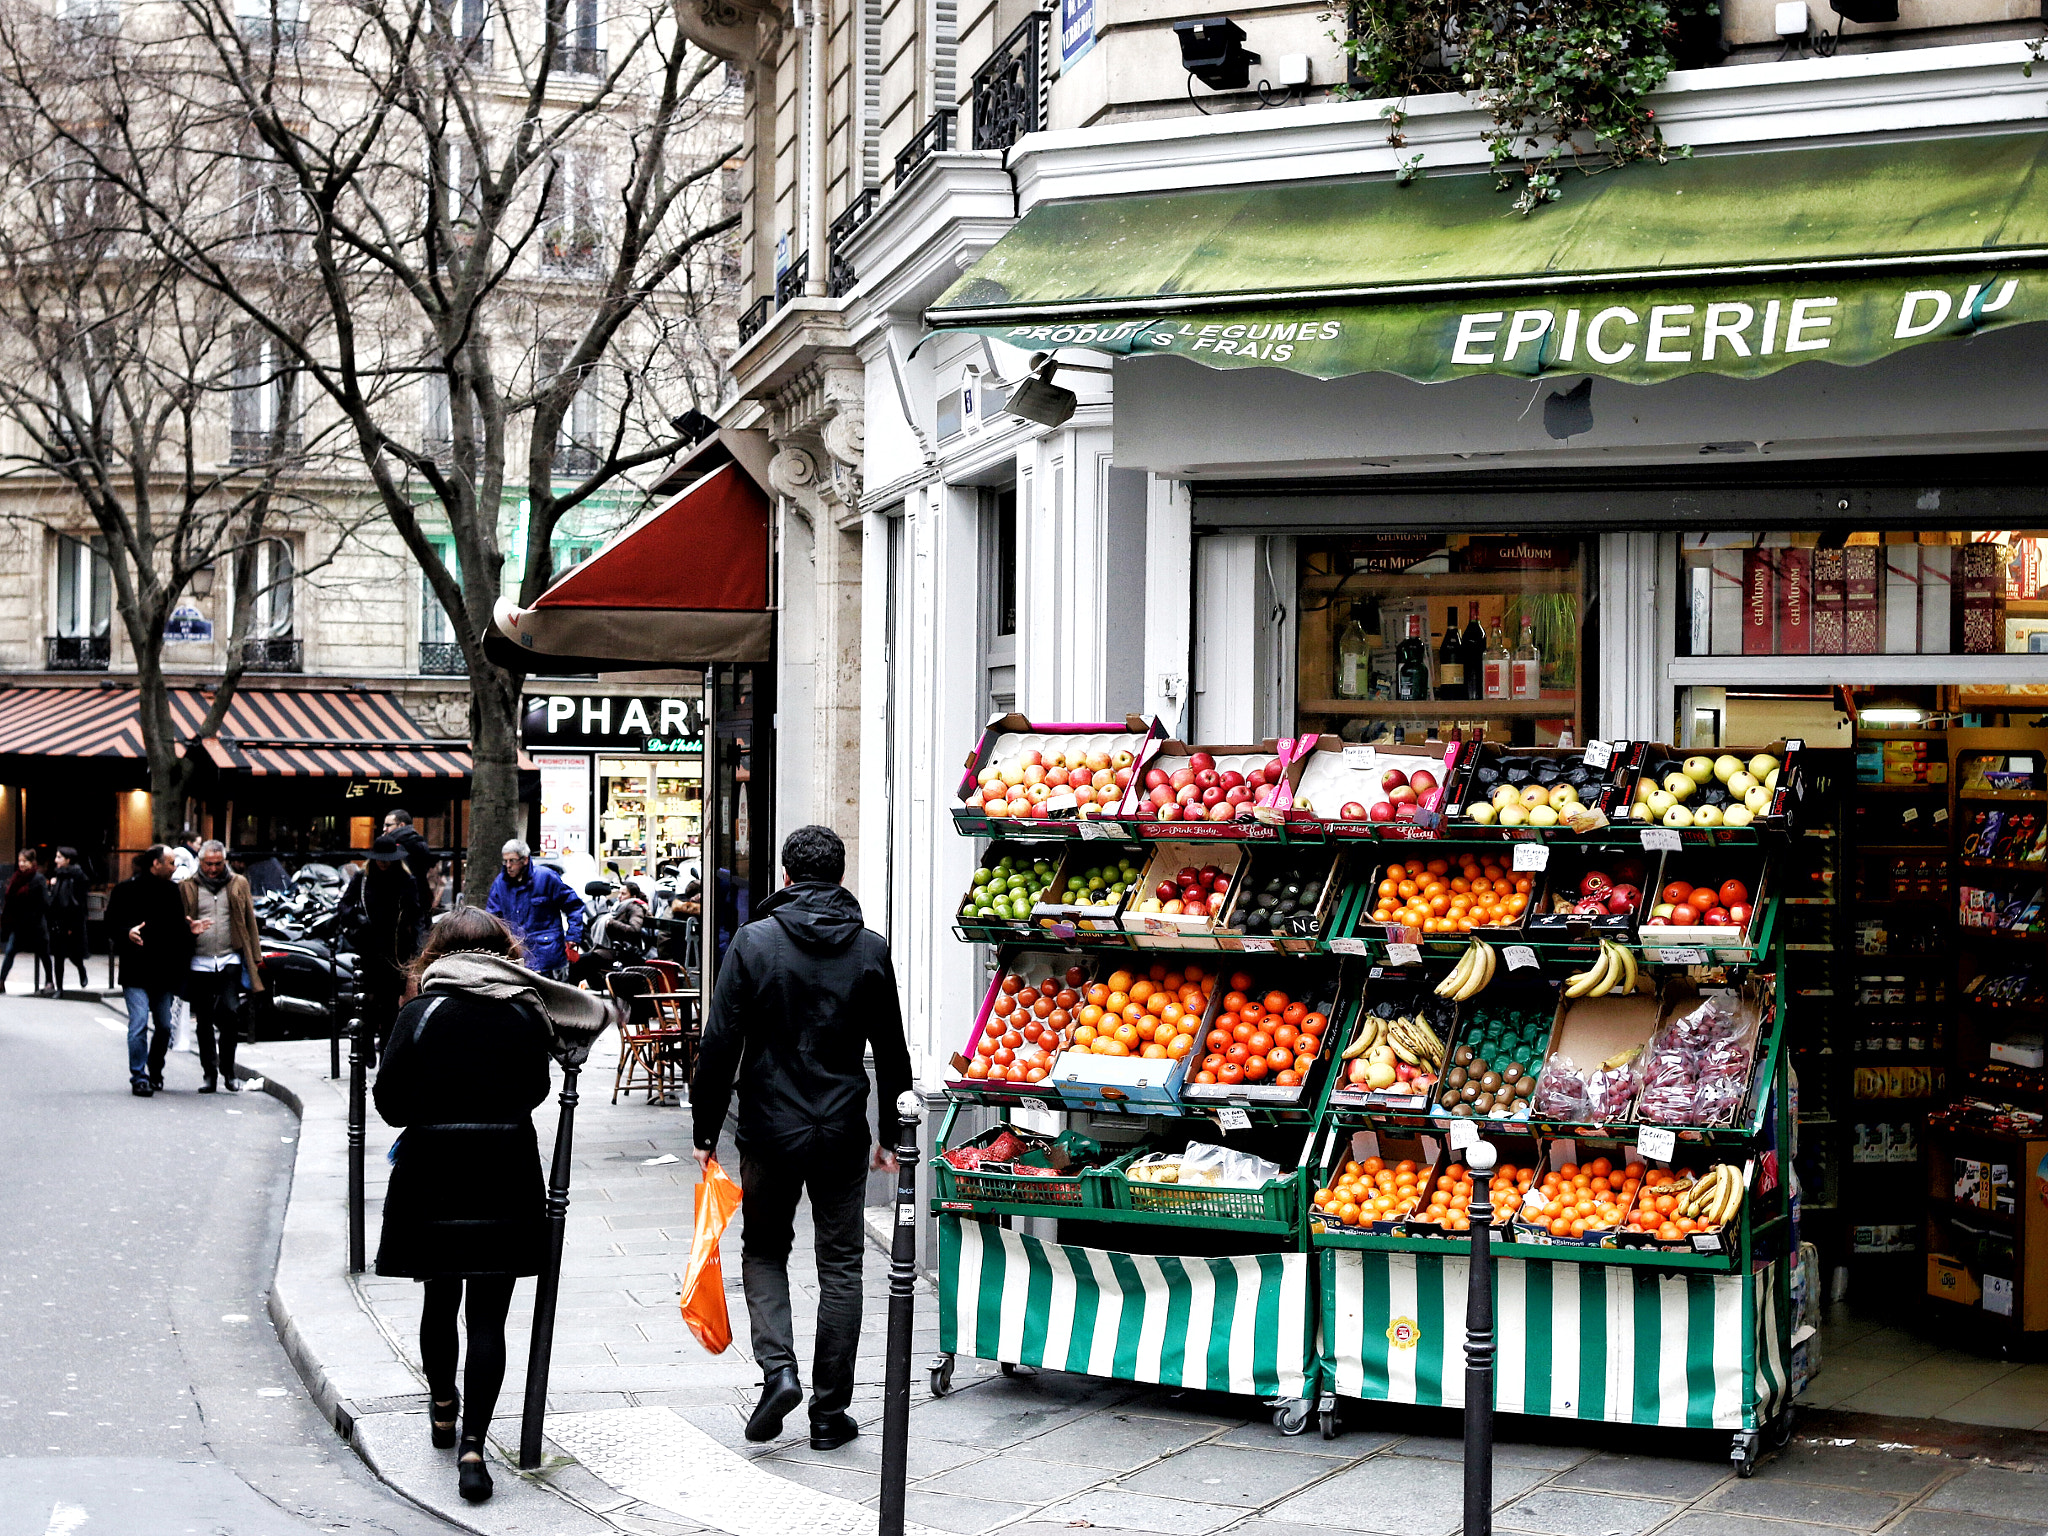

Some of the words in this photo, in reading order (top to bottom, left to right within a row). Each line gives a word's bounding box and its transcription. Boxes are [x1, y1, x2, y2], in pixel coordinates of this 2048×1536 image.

[1177, 320, 1343, 342] LEGUMES
[1450, 295, 1839, 365] EPICERIE
[1191, 338, 1296, 362] FRAIS
[547, 696, 704, 736] PHAR
